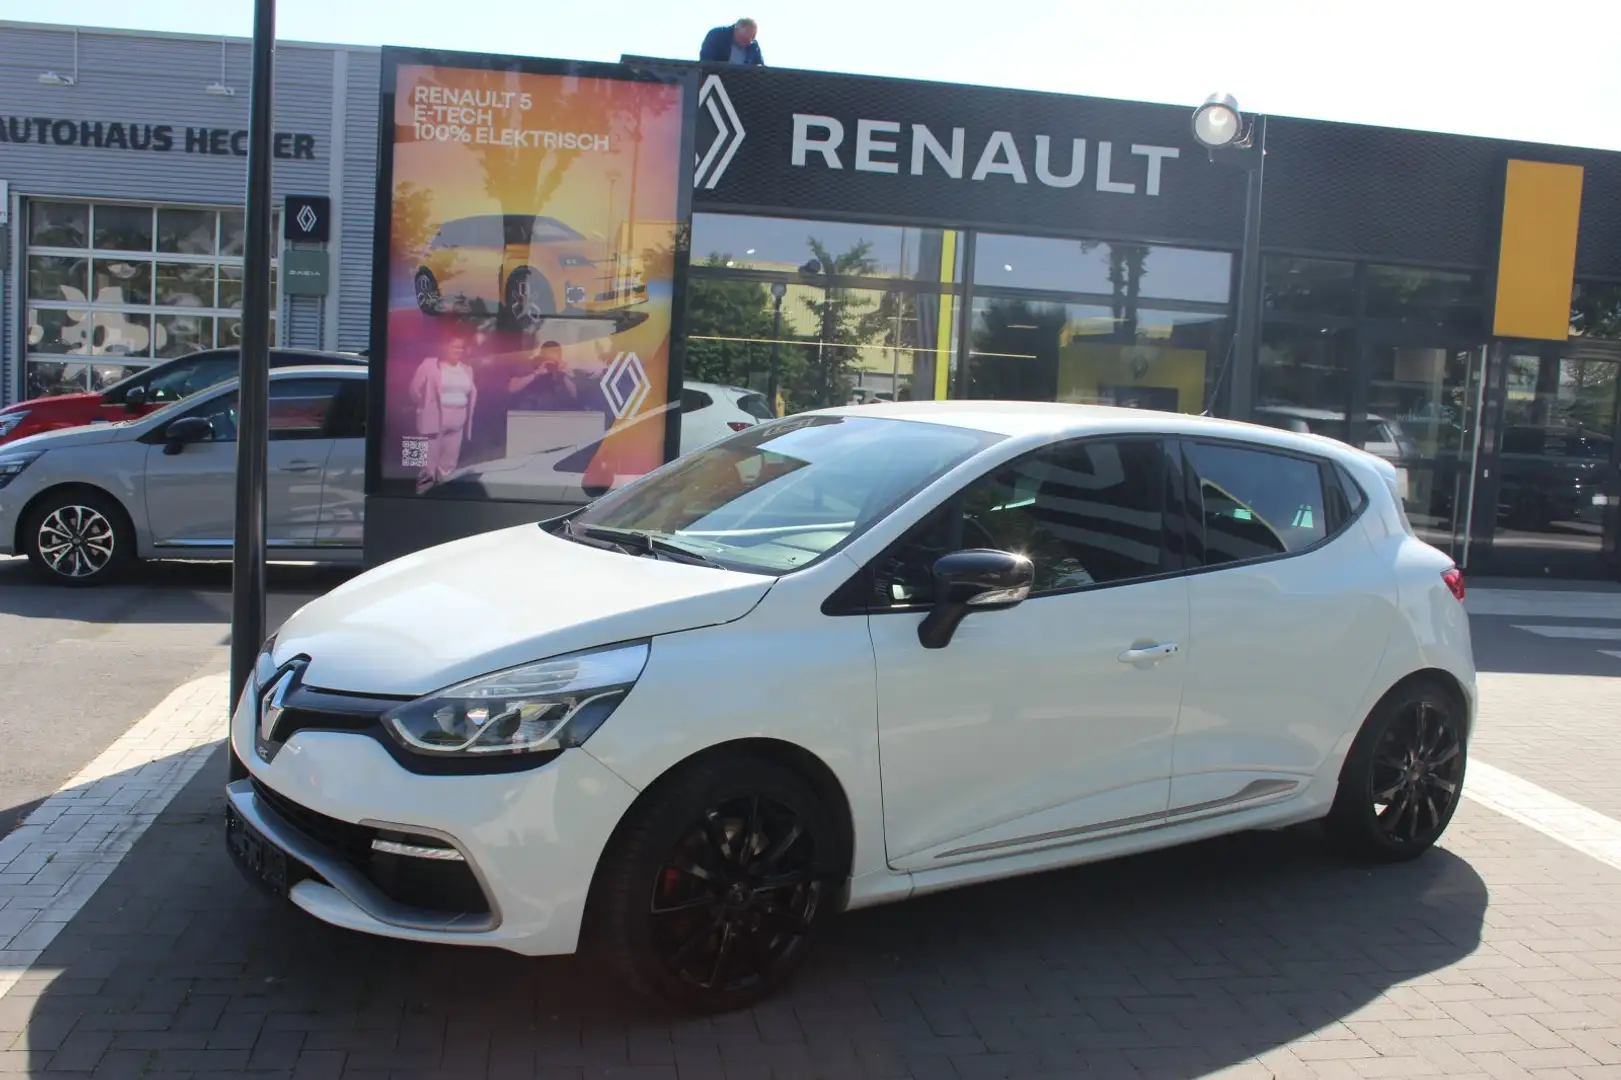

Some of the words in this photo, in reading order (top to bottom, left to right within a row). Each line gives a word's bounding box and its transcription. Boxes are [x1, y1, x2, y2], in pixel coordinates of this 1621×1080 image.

[414, 85, 516, 109] RENAULT
[519, 93, 533, 110] 5
[414, 103, 492, 126] E-TECH
[185, 127, 315, 160] HECER
[414, 122, 471, 143] 100%
[475, 126, 610, 151] ELEKTRISCH
[791, 113, 1180, 196] RENAULT
